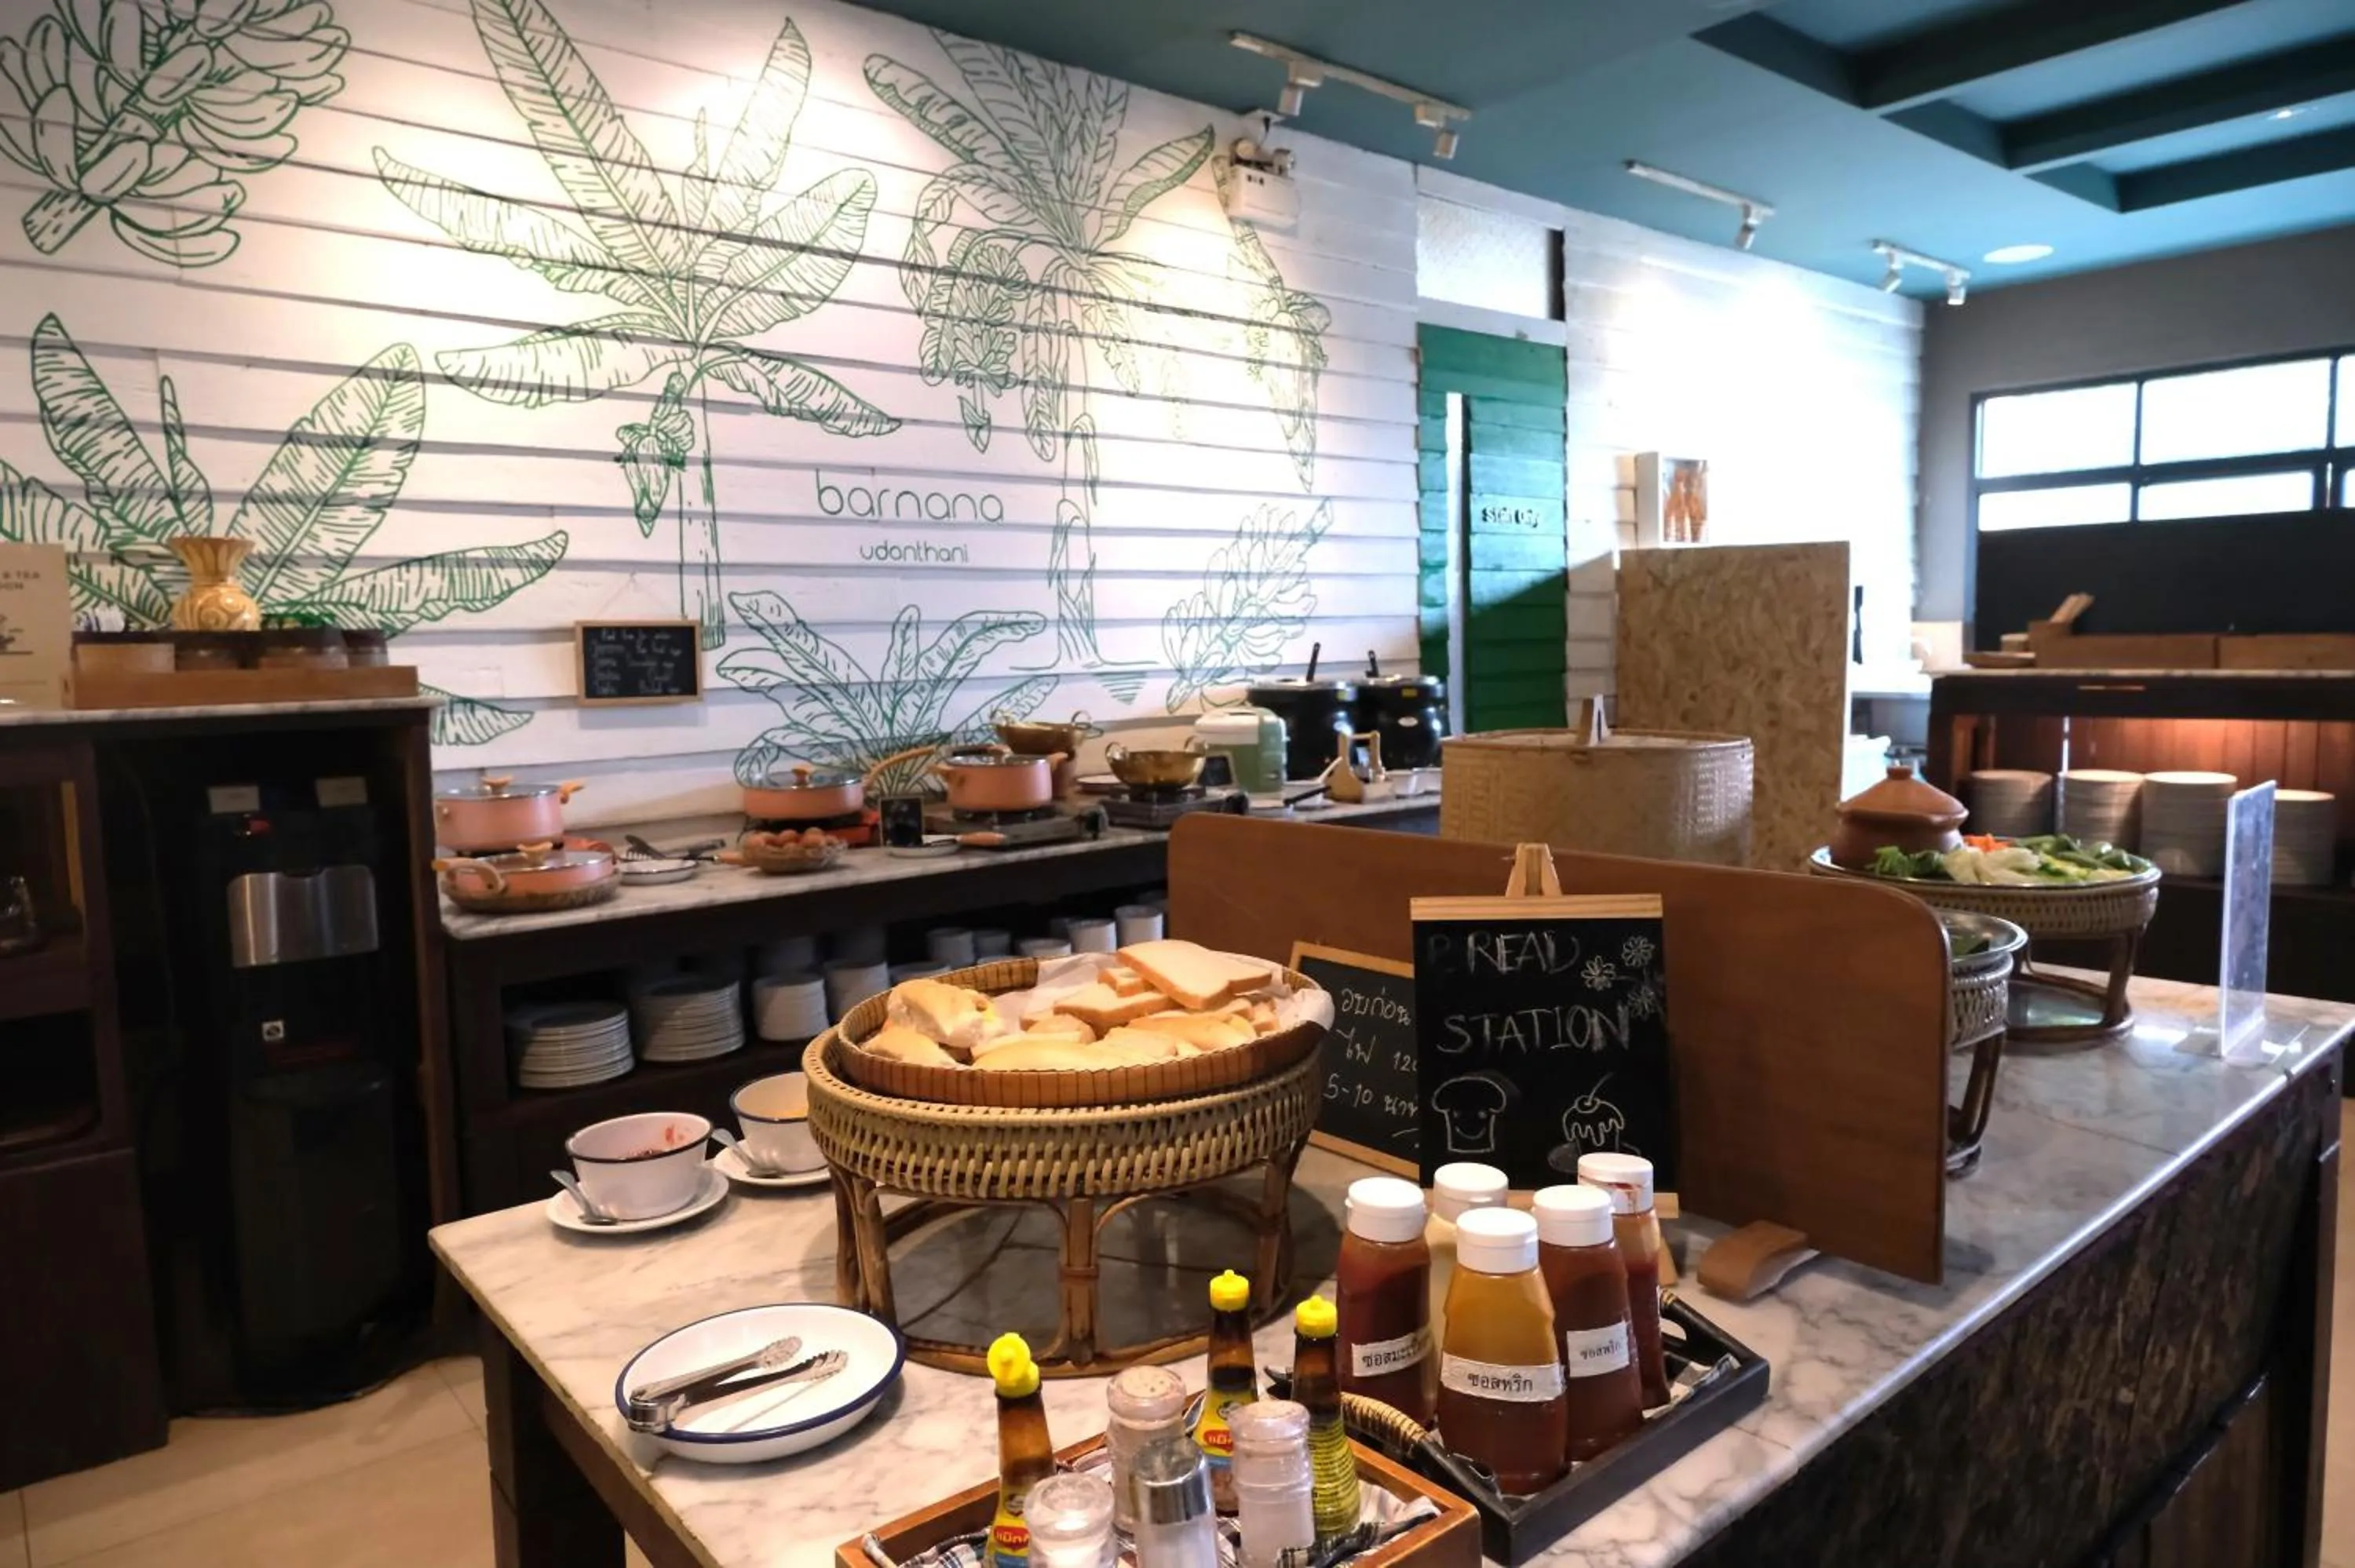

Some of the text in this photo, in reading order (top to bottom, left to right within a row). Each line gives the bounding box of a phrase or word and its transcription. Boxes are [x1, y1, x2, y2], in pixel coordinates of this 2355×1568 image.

[815, 468, 1004, 523] barnana
[860, 540, 969, 563] udonthani
[1436, 1002, 1630, 1055] STATION
[1323, 1072, 1374, 1108] 5-10
[1466, 1372, 1533, 1393] ซอสพริก
